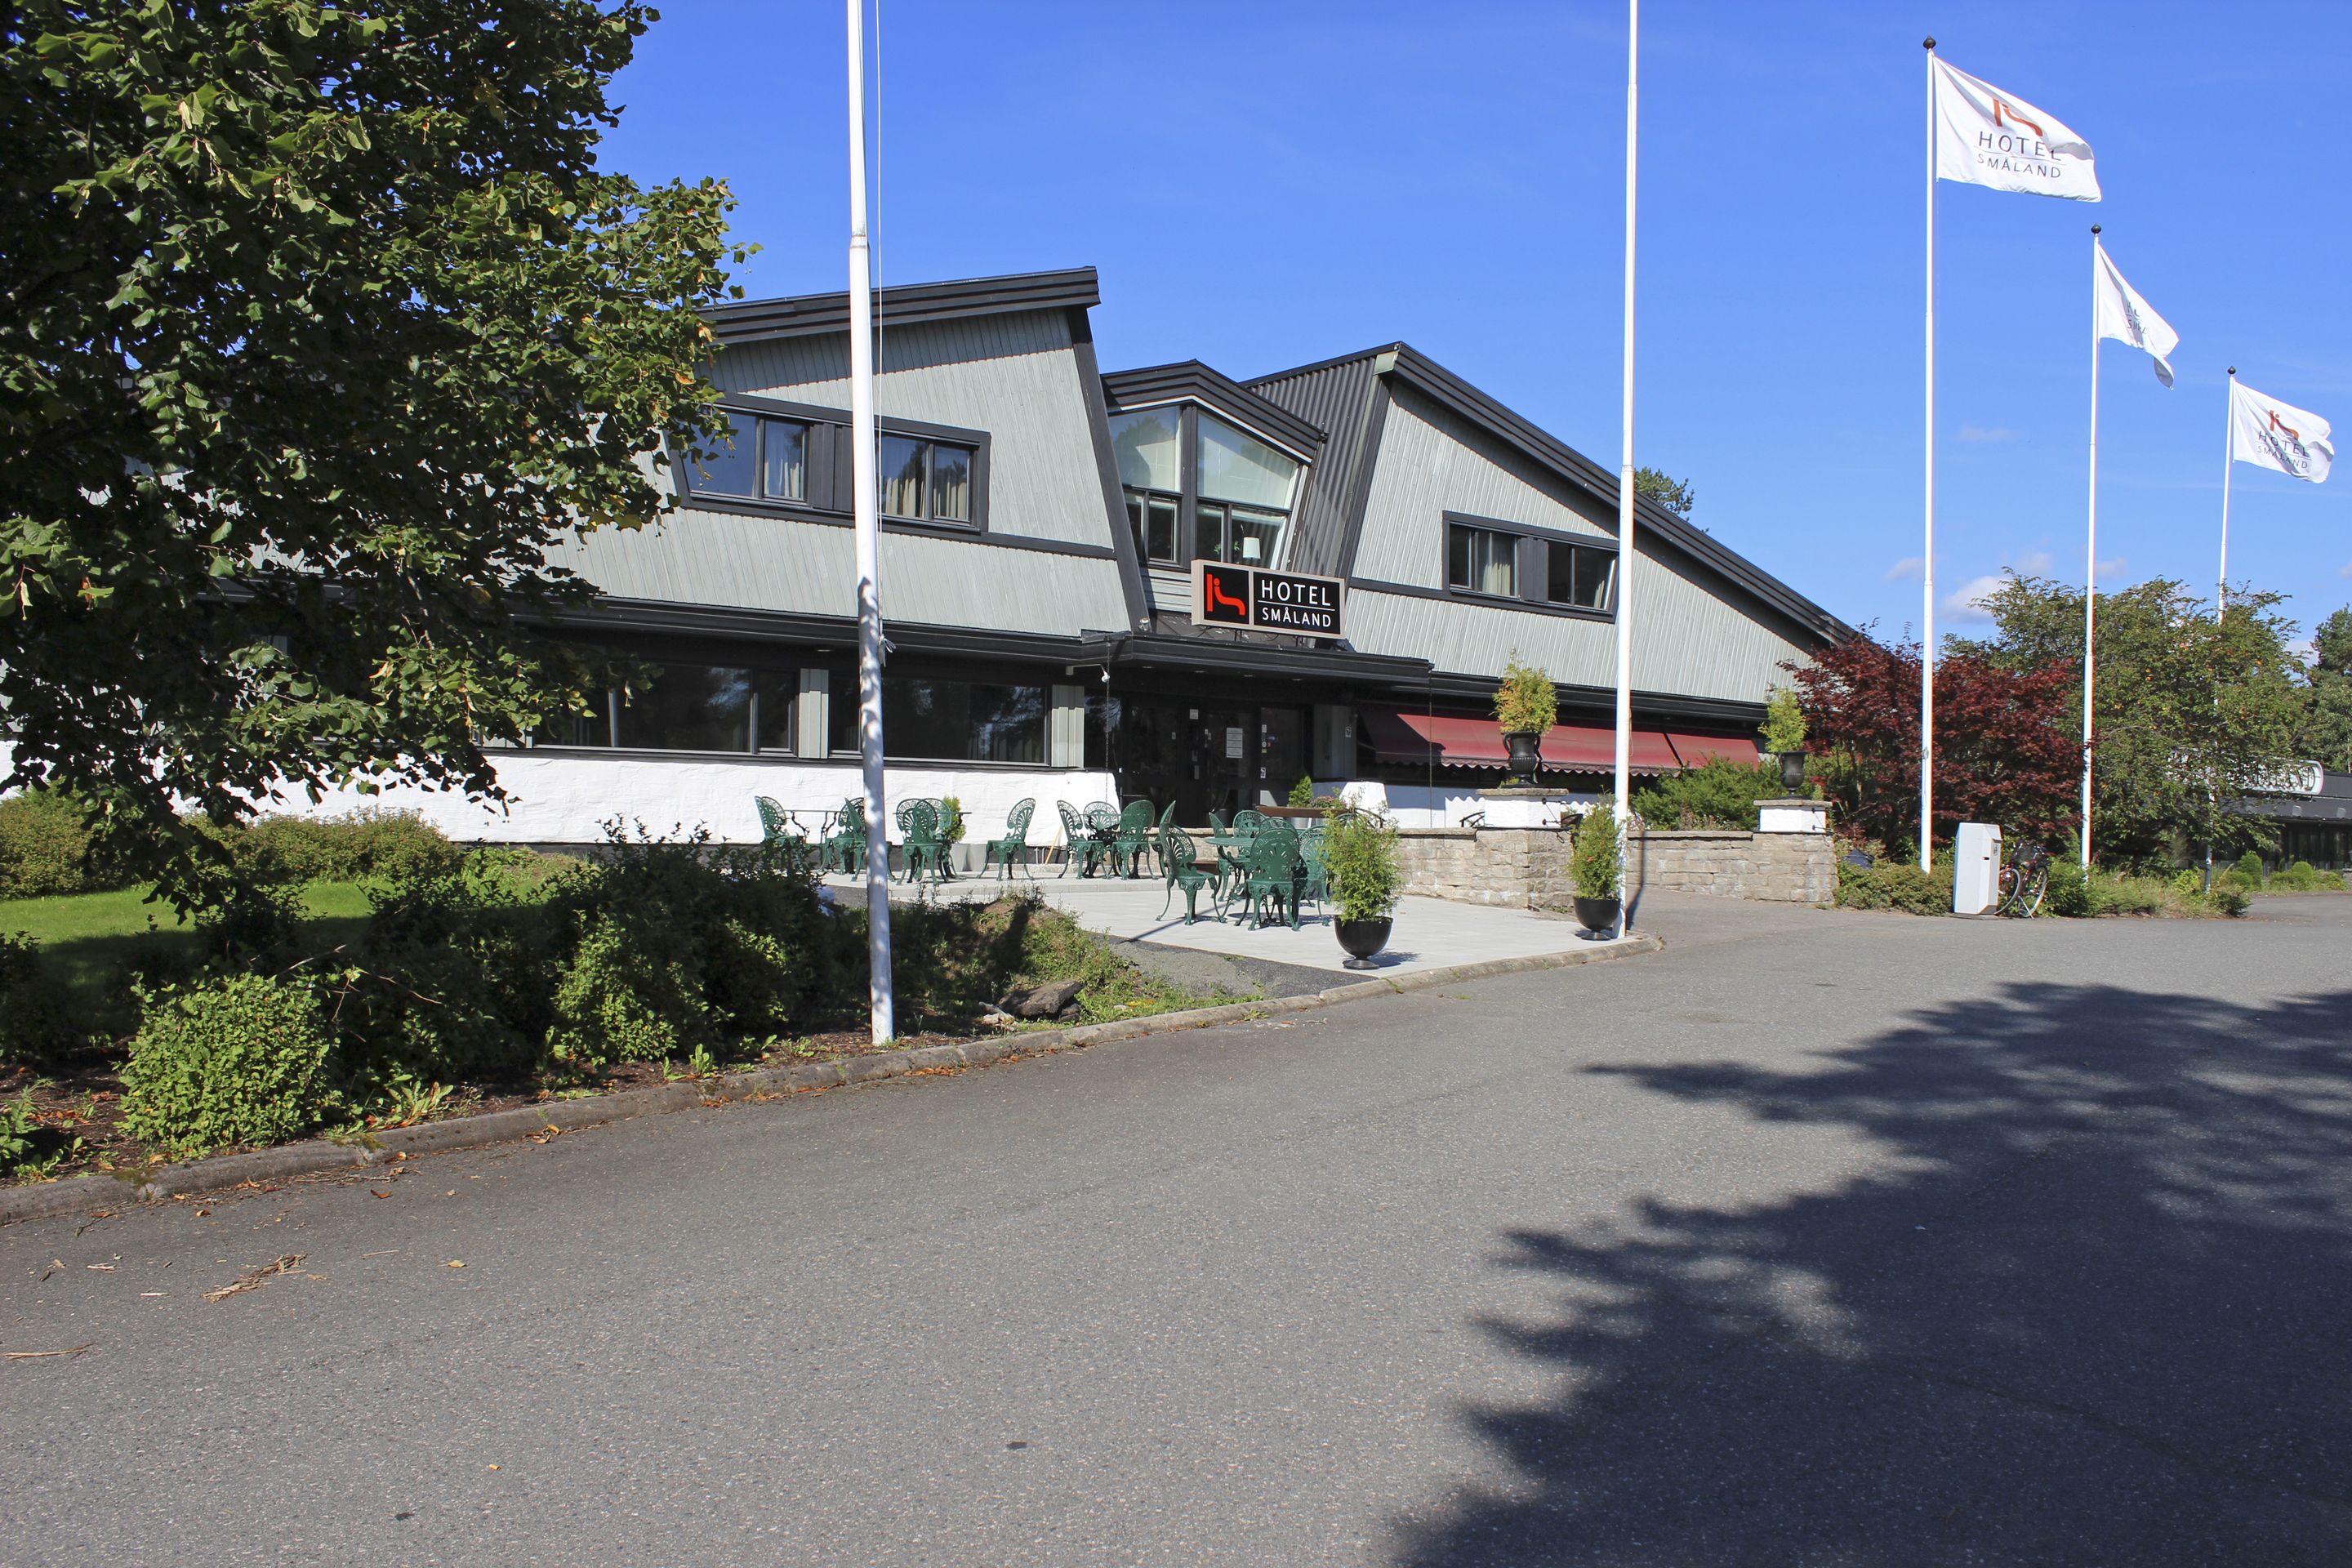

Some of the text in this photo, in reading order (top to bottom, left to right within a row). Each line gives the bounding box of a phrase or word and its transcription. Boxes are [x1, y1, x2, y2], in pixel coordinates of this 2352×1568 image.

[1979, 131, 2062, 161] HOTEL
[1977, 154, 2061, 178] SMÅLAND
[2258, 430, 2310, 457] HOTEL
[1262, 579, 1331, 607] HOTEL
[1262, 607, 1331, 627] SMÅLAND
